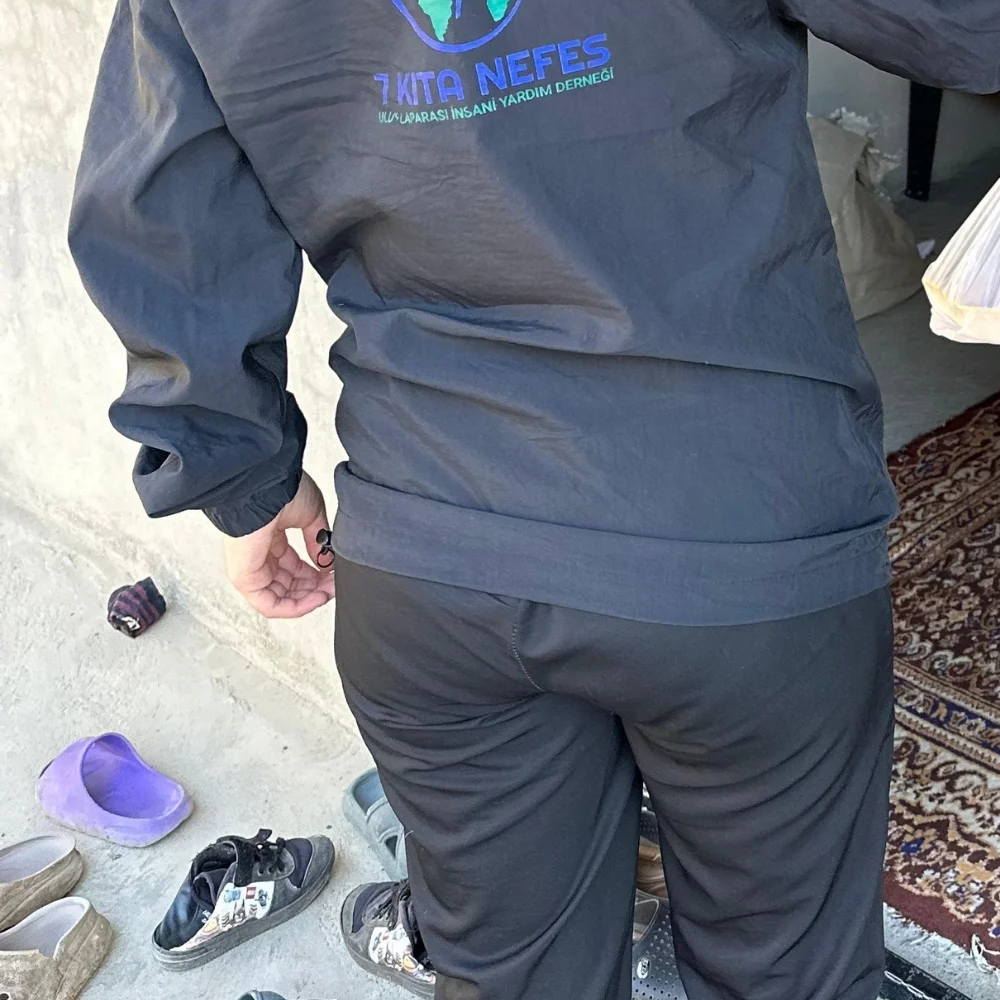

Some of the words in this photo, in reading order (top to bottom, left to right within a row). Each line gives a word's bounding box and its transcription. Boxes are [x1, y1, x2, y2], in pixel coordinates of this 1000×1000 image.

[373, 72, 389, 106] 7
[397, 68, 465, 106] KITA
[475, 32, 612, 97] NEFES
[450, 96, 498, 121] İNSANİ
[498, 83, 553, 109] YARDIM
[554, 66, 615, 94] DERNEĞİ
